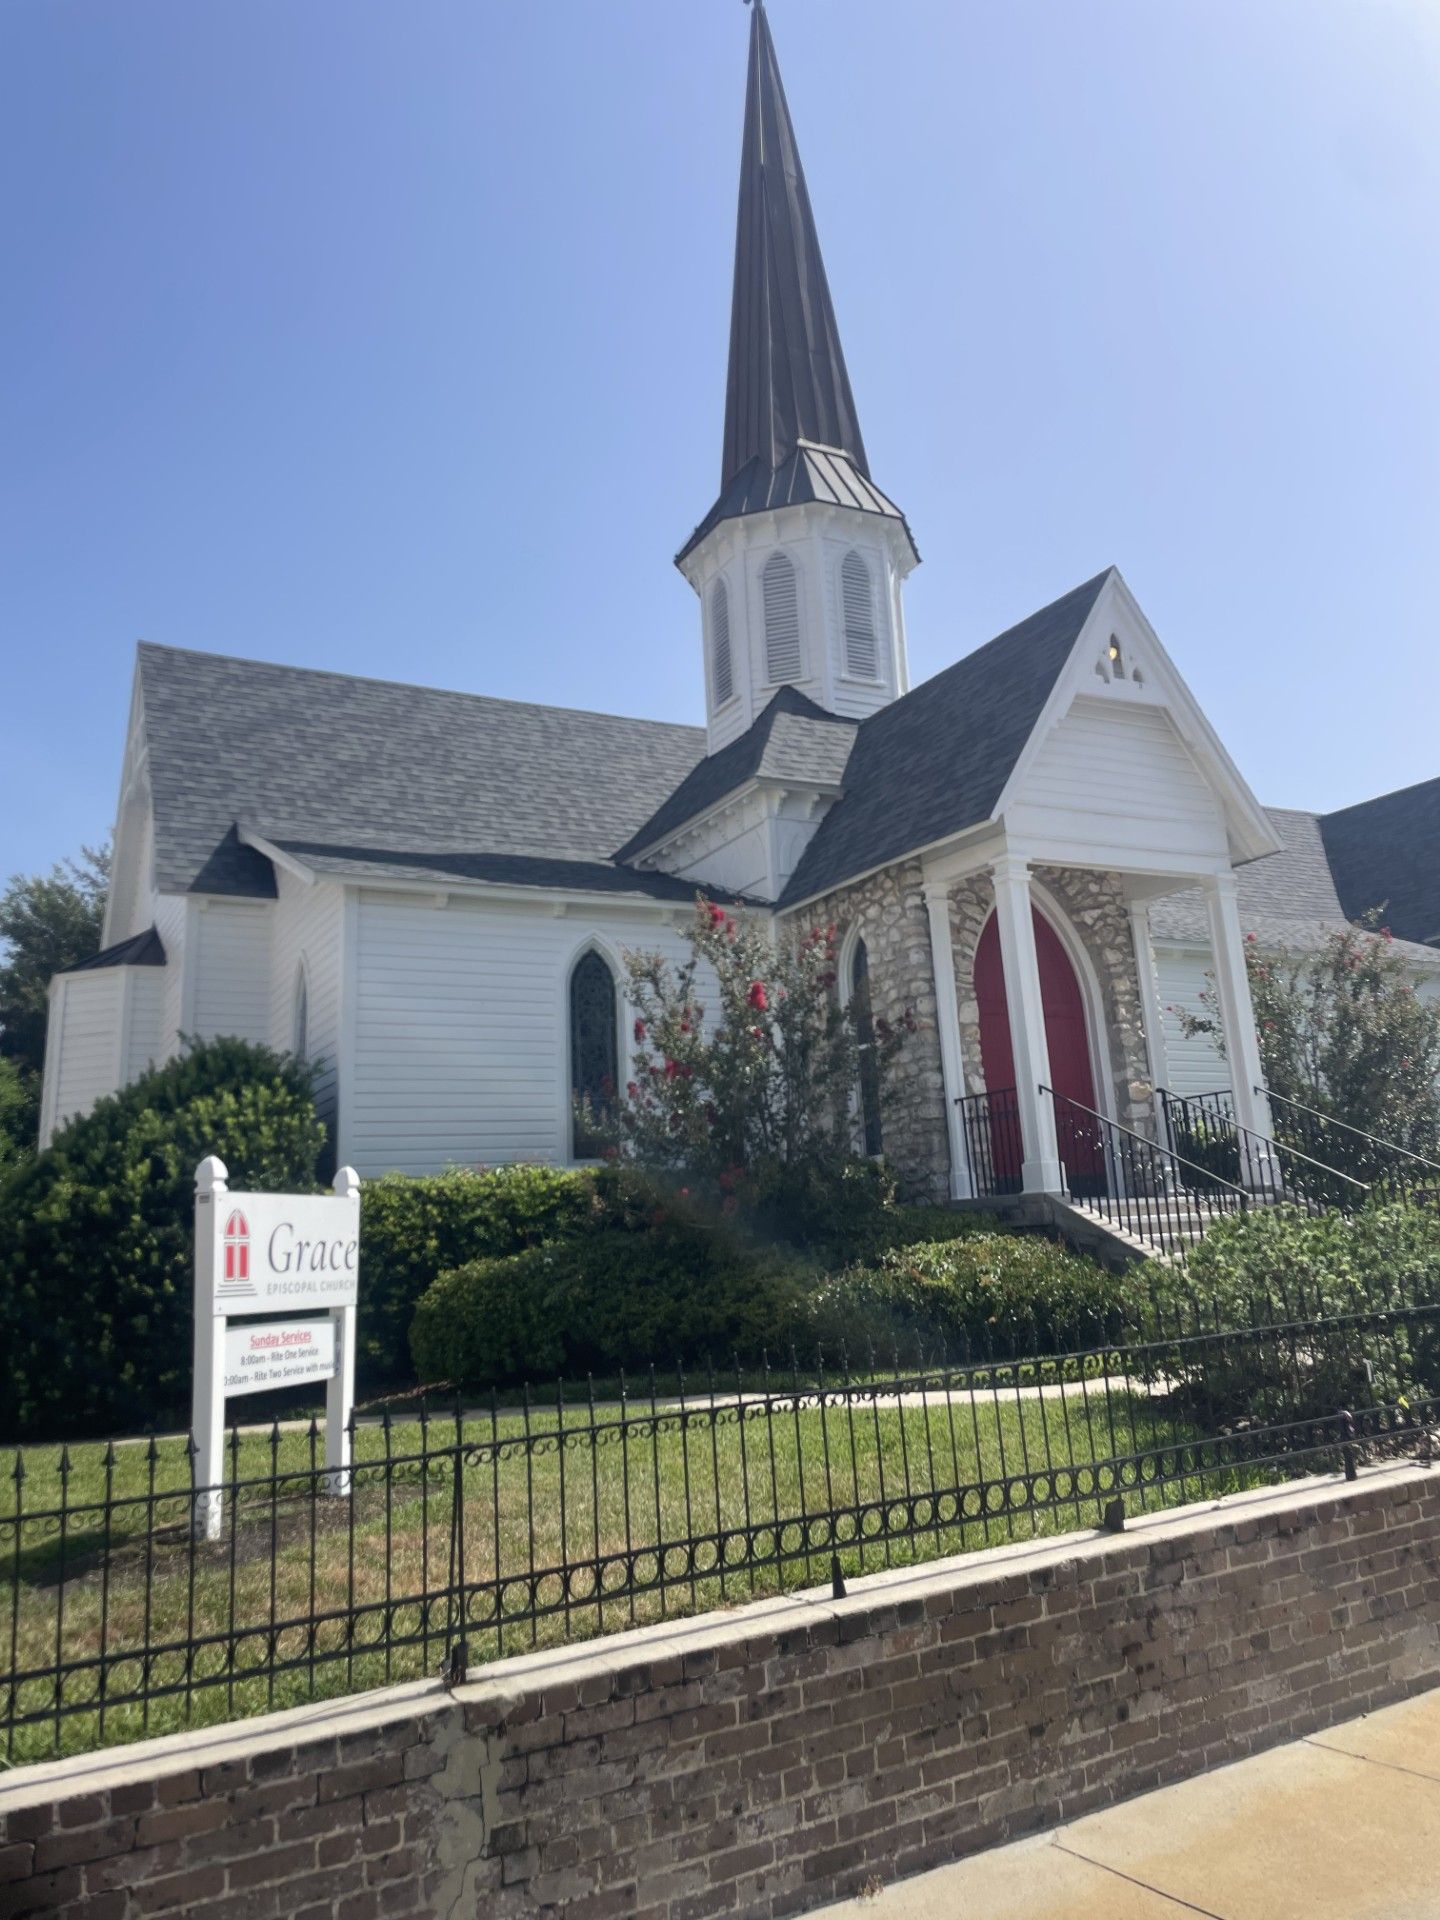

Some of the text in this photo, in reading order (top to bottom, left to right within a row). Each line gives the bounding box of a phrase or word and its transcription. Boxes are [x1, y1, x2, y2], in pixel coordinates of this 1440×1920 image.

[268, 1222, 357, 1273] Grace
[267, 1279, 356, 1295] EPISCOPAL CHURCH
[250, 1330, 312, 1349] Sunday Services
[240, 1354, 266, 1366] 8:00am
[271, 1350, 283, 1361] Rite
[285, 1349, 298, 1360] One
[299, 1347, 319, 1358] Service
[254, 1370, 268, 1381] Rite
[269, 1368, 282, 1379] Two
[283, 1366, 305, 1377] Service
[306, 1363, 319, 1373] with
